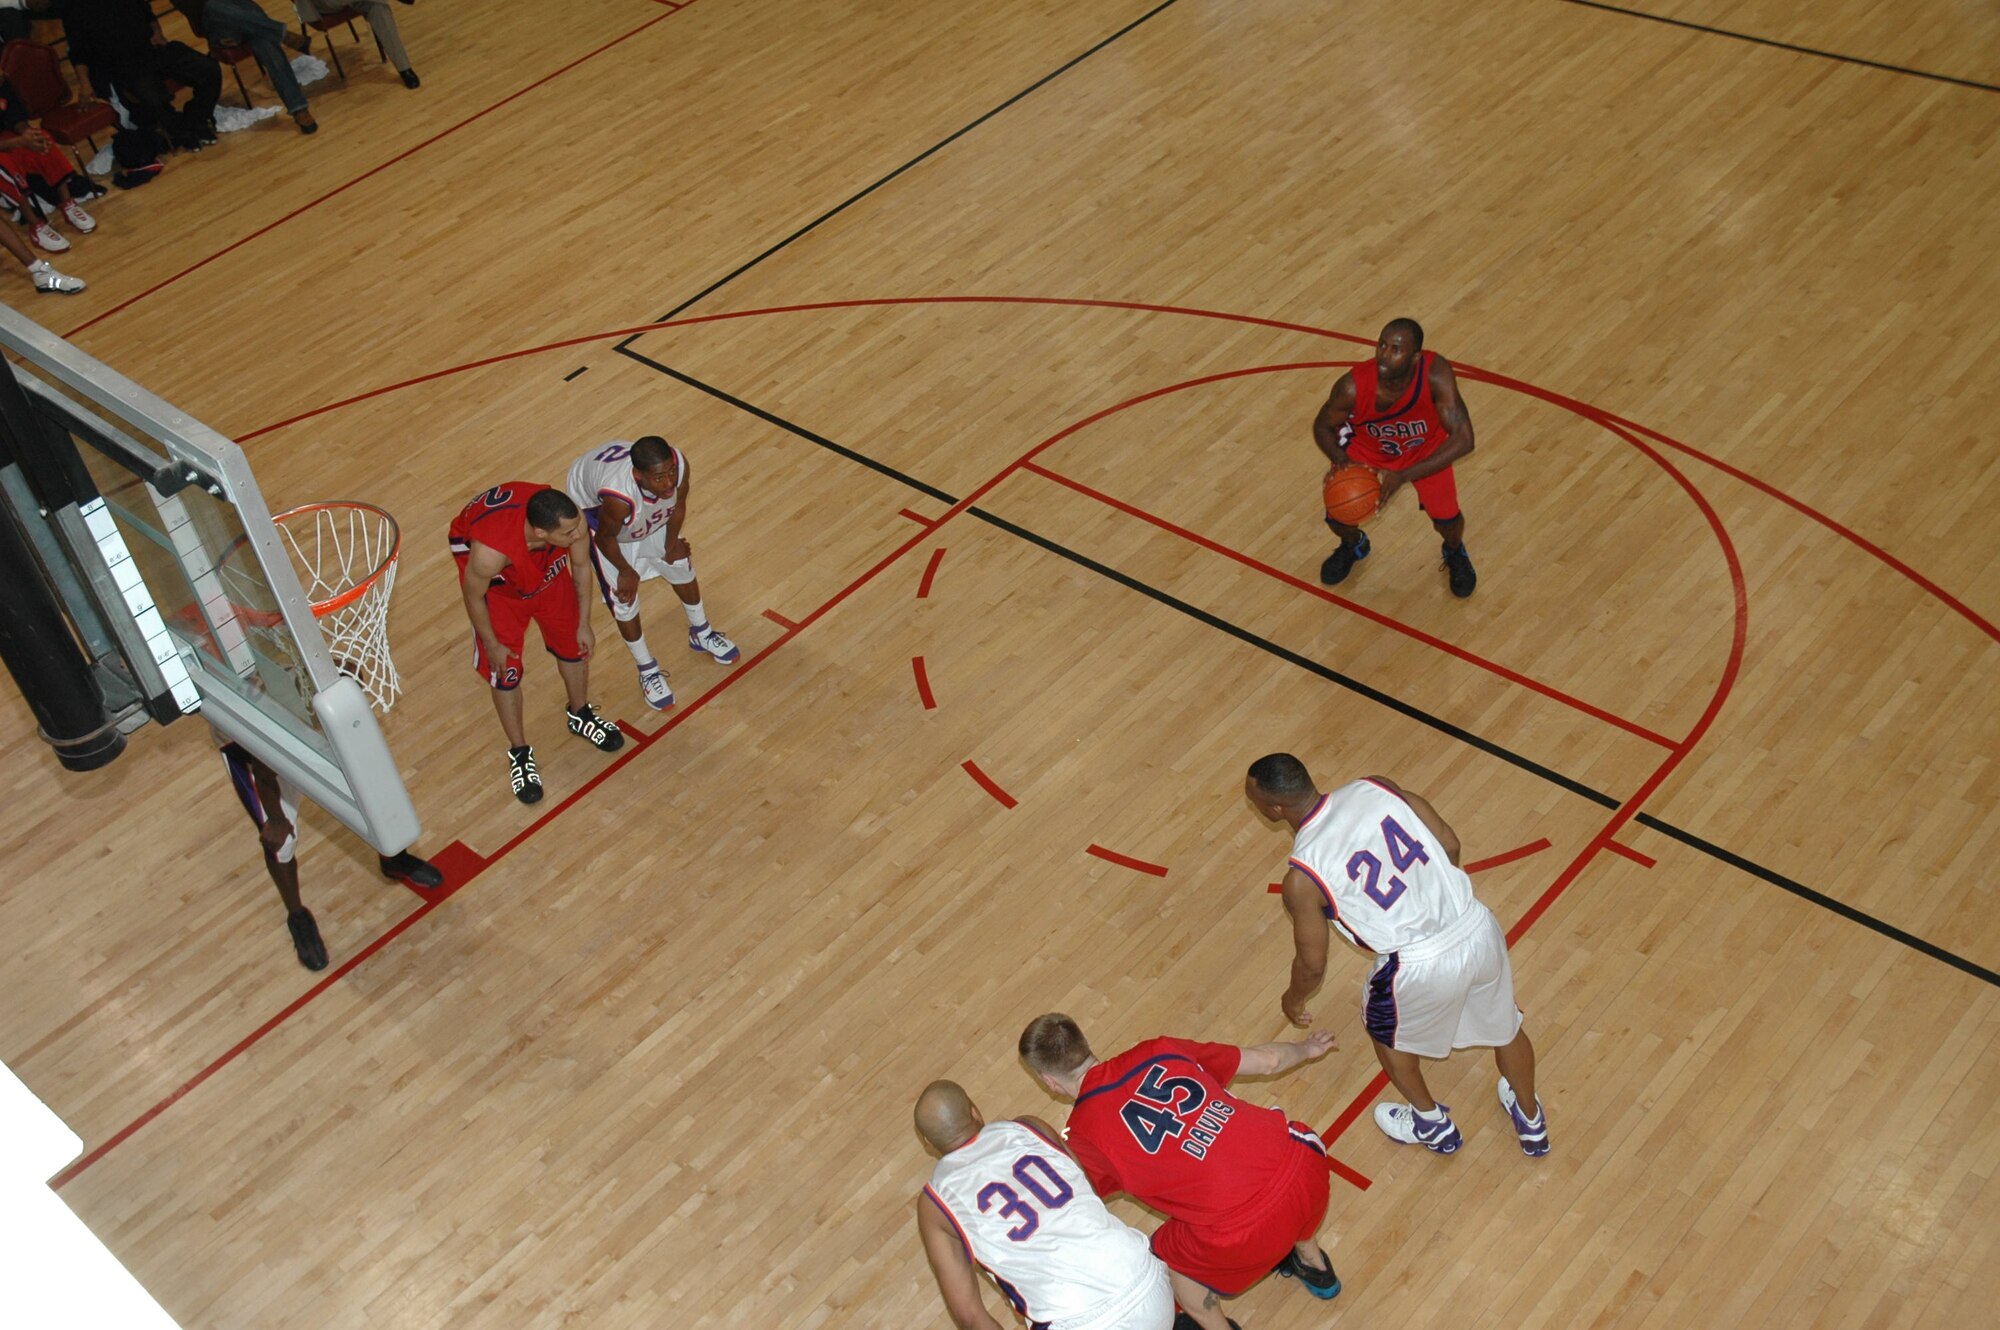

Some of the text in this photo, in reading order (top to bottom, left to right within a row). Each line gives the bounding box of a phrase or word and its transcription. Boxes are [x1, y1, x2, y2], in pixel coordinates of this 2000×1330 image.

[505, 667, 518, 683] 2
[1346, 815, 1430, 912] 24
[1119, 1063, 1207, 1155] 45
[1181, 1099, 1235, 1161] DAVIS
[977, 1155, 1074, 1242] 30
